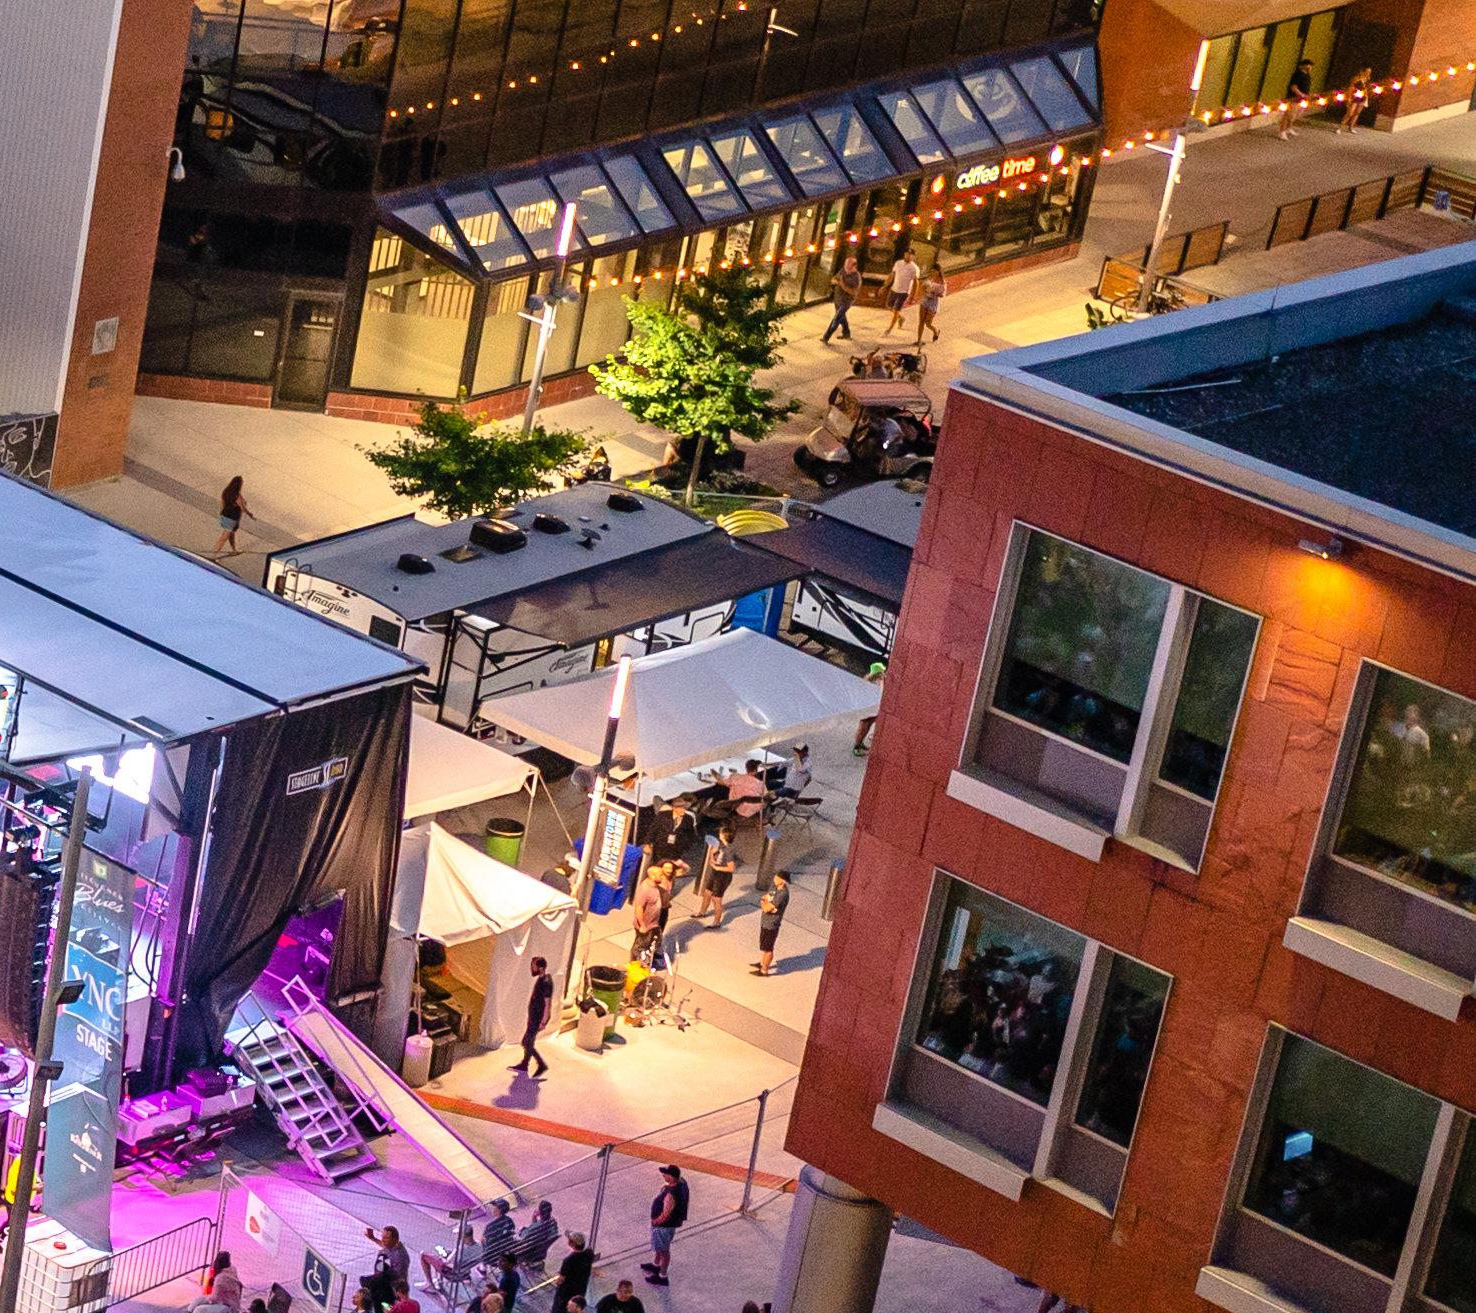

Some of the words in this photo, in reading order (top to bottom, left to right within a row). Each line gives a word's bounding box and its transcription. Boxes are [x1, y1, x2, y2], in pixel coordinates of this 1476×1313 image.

[956, 164, 1000, 190] coffee
[1002, 156, 1036, 178] time
[301, 588, 352, 617] Imagine
[75, 881, 125, 914] Blues
[76, 1023, 113, 1062] STAGE
